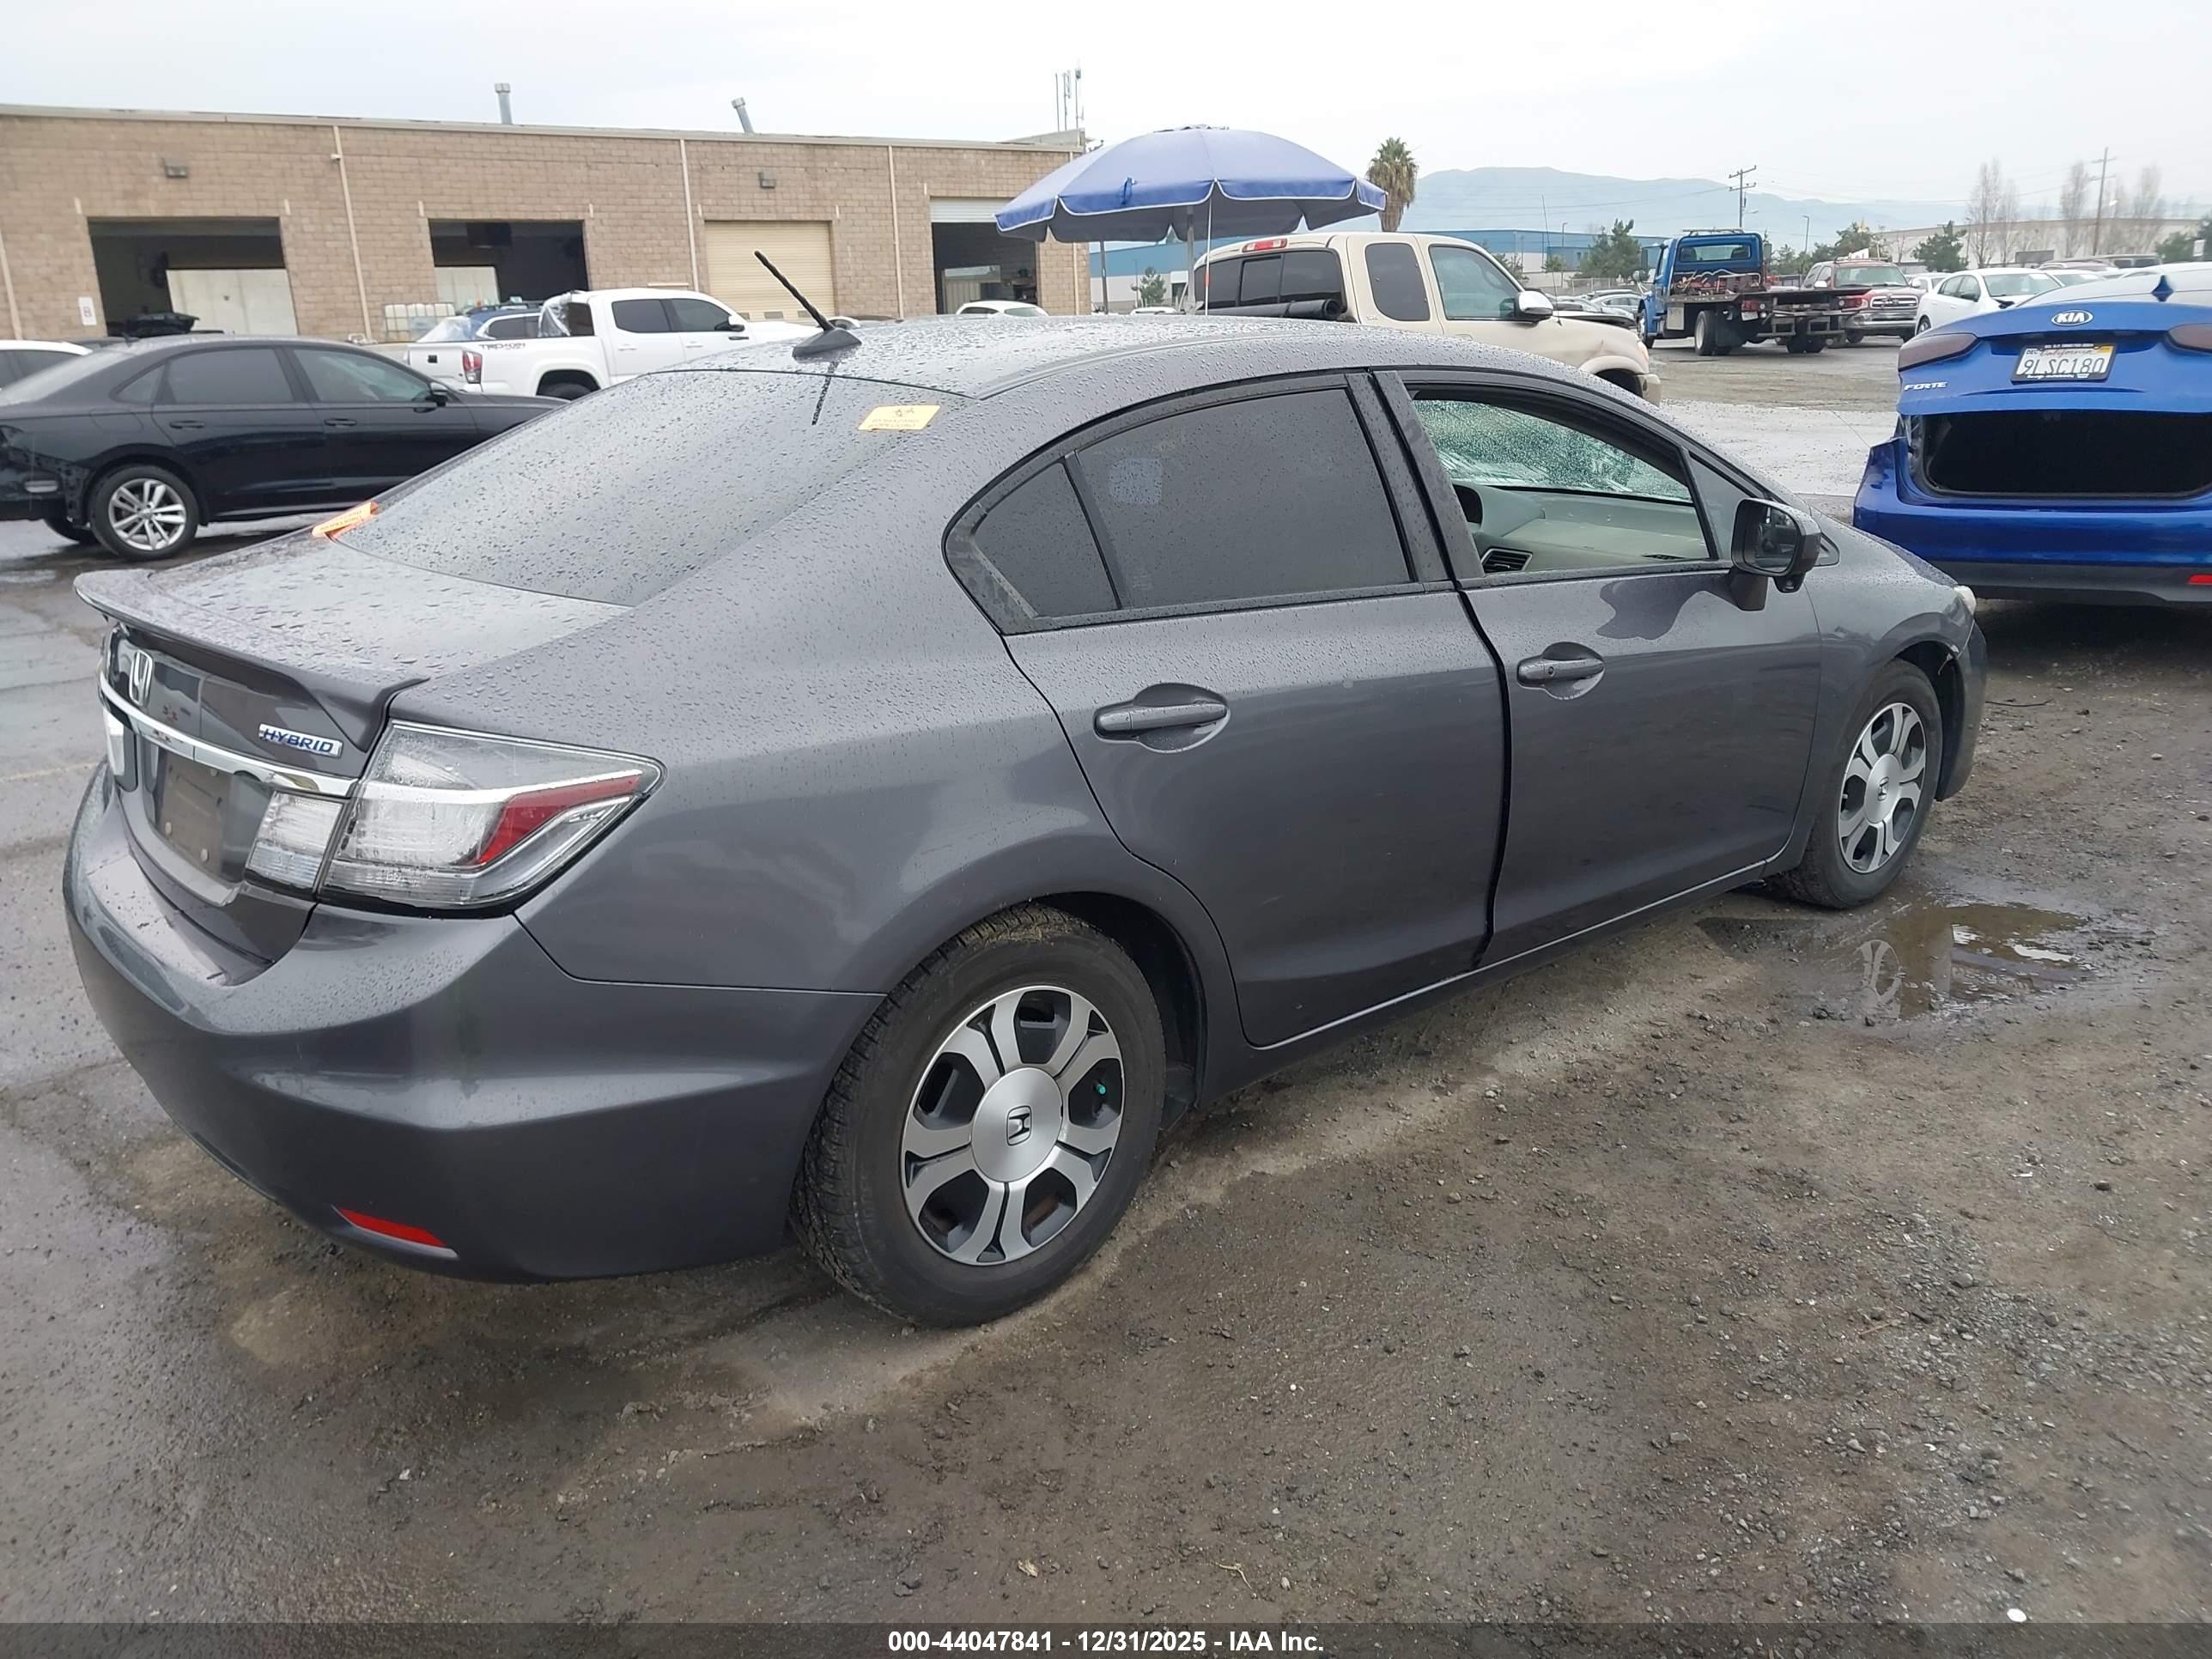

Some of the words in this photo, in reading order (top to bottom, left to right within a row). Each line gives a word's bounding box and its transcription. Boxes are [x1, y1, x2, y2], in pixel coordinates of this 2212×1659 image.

[2057, 312, 2085, 323] KIA
[2021, 358, 2106, 375] 9LSC180
[1904, 381, 1948, 391] FORTE
[263, 728, 334, 753] HYBRID
